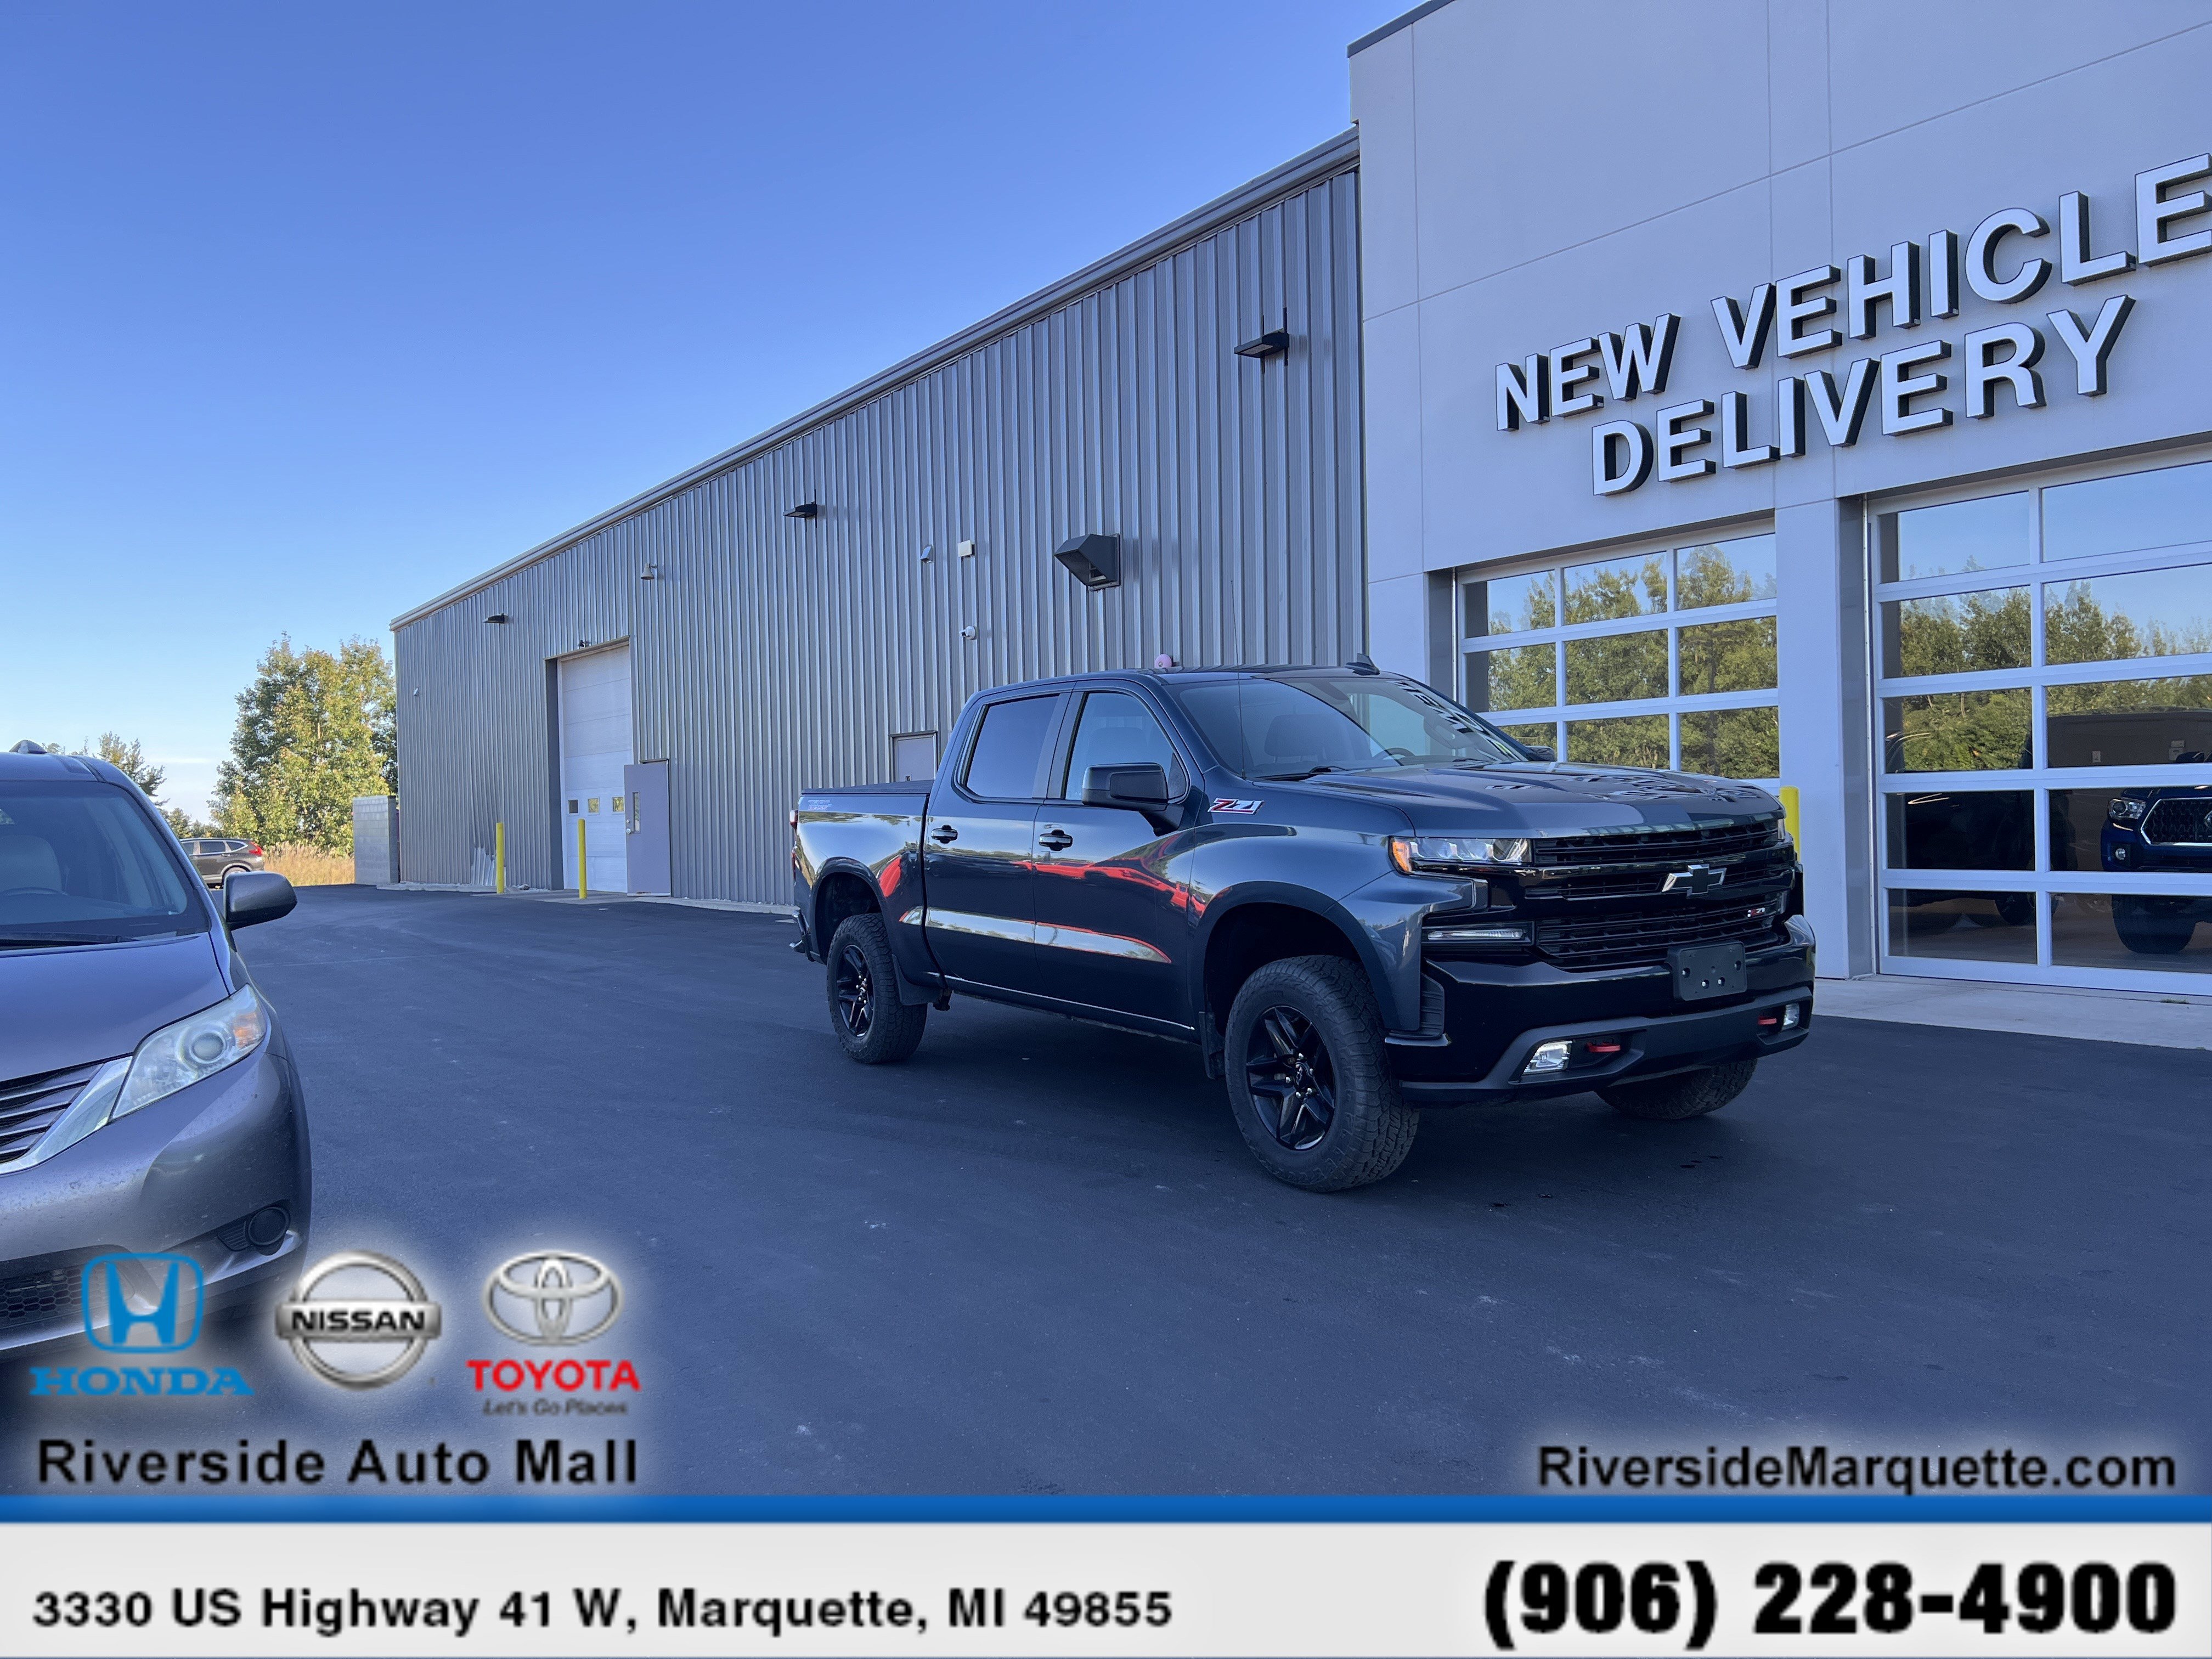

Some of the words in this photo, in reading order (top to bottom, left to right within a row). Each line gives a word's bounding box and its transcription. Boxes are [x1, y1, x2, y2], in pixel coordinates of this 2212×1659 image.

[1496, 313, 1681, 432] NEW
[1710, 153, 2212, 370] VEHICLE
[1592, 295, 2136, 496] DELIVERY
[1207, 798, 1265, 815] Z71
